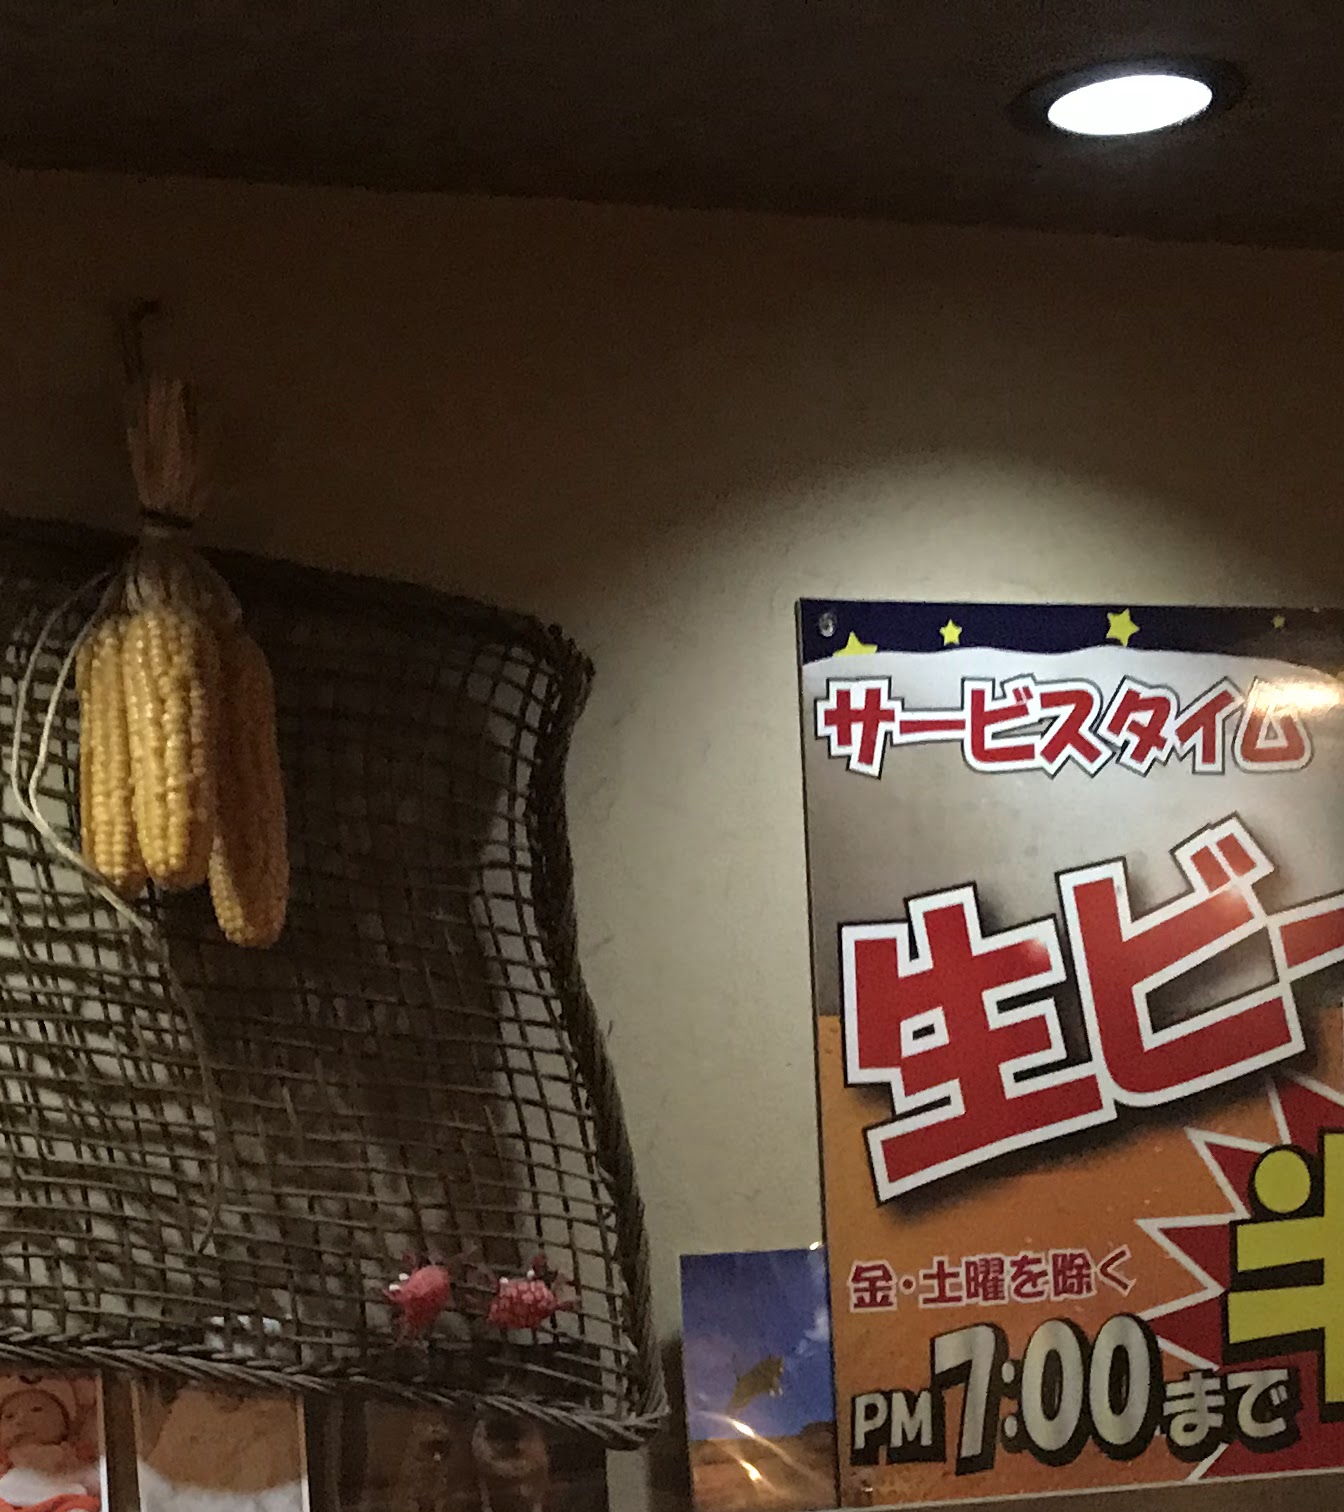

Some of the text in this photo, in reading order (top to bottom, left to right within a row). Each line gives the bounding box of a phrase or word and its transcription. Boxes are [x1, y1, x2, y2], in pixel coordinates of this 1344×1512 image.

[816, 674, 1315, 778] サービスタイム
[846, 1245, 1138, 1313] 金・土曜を除く
